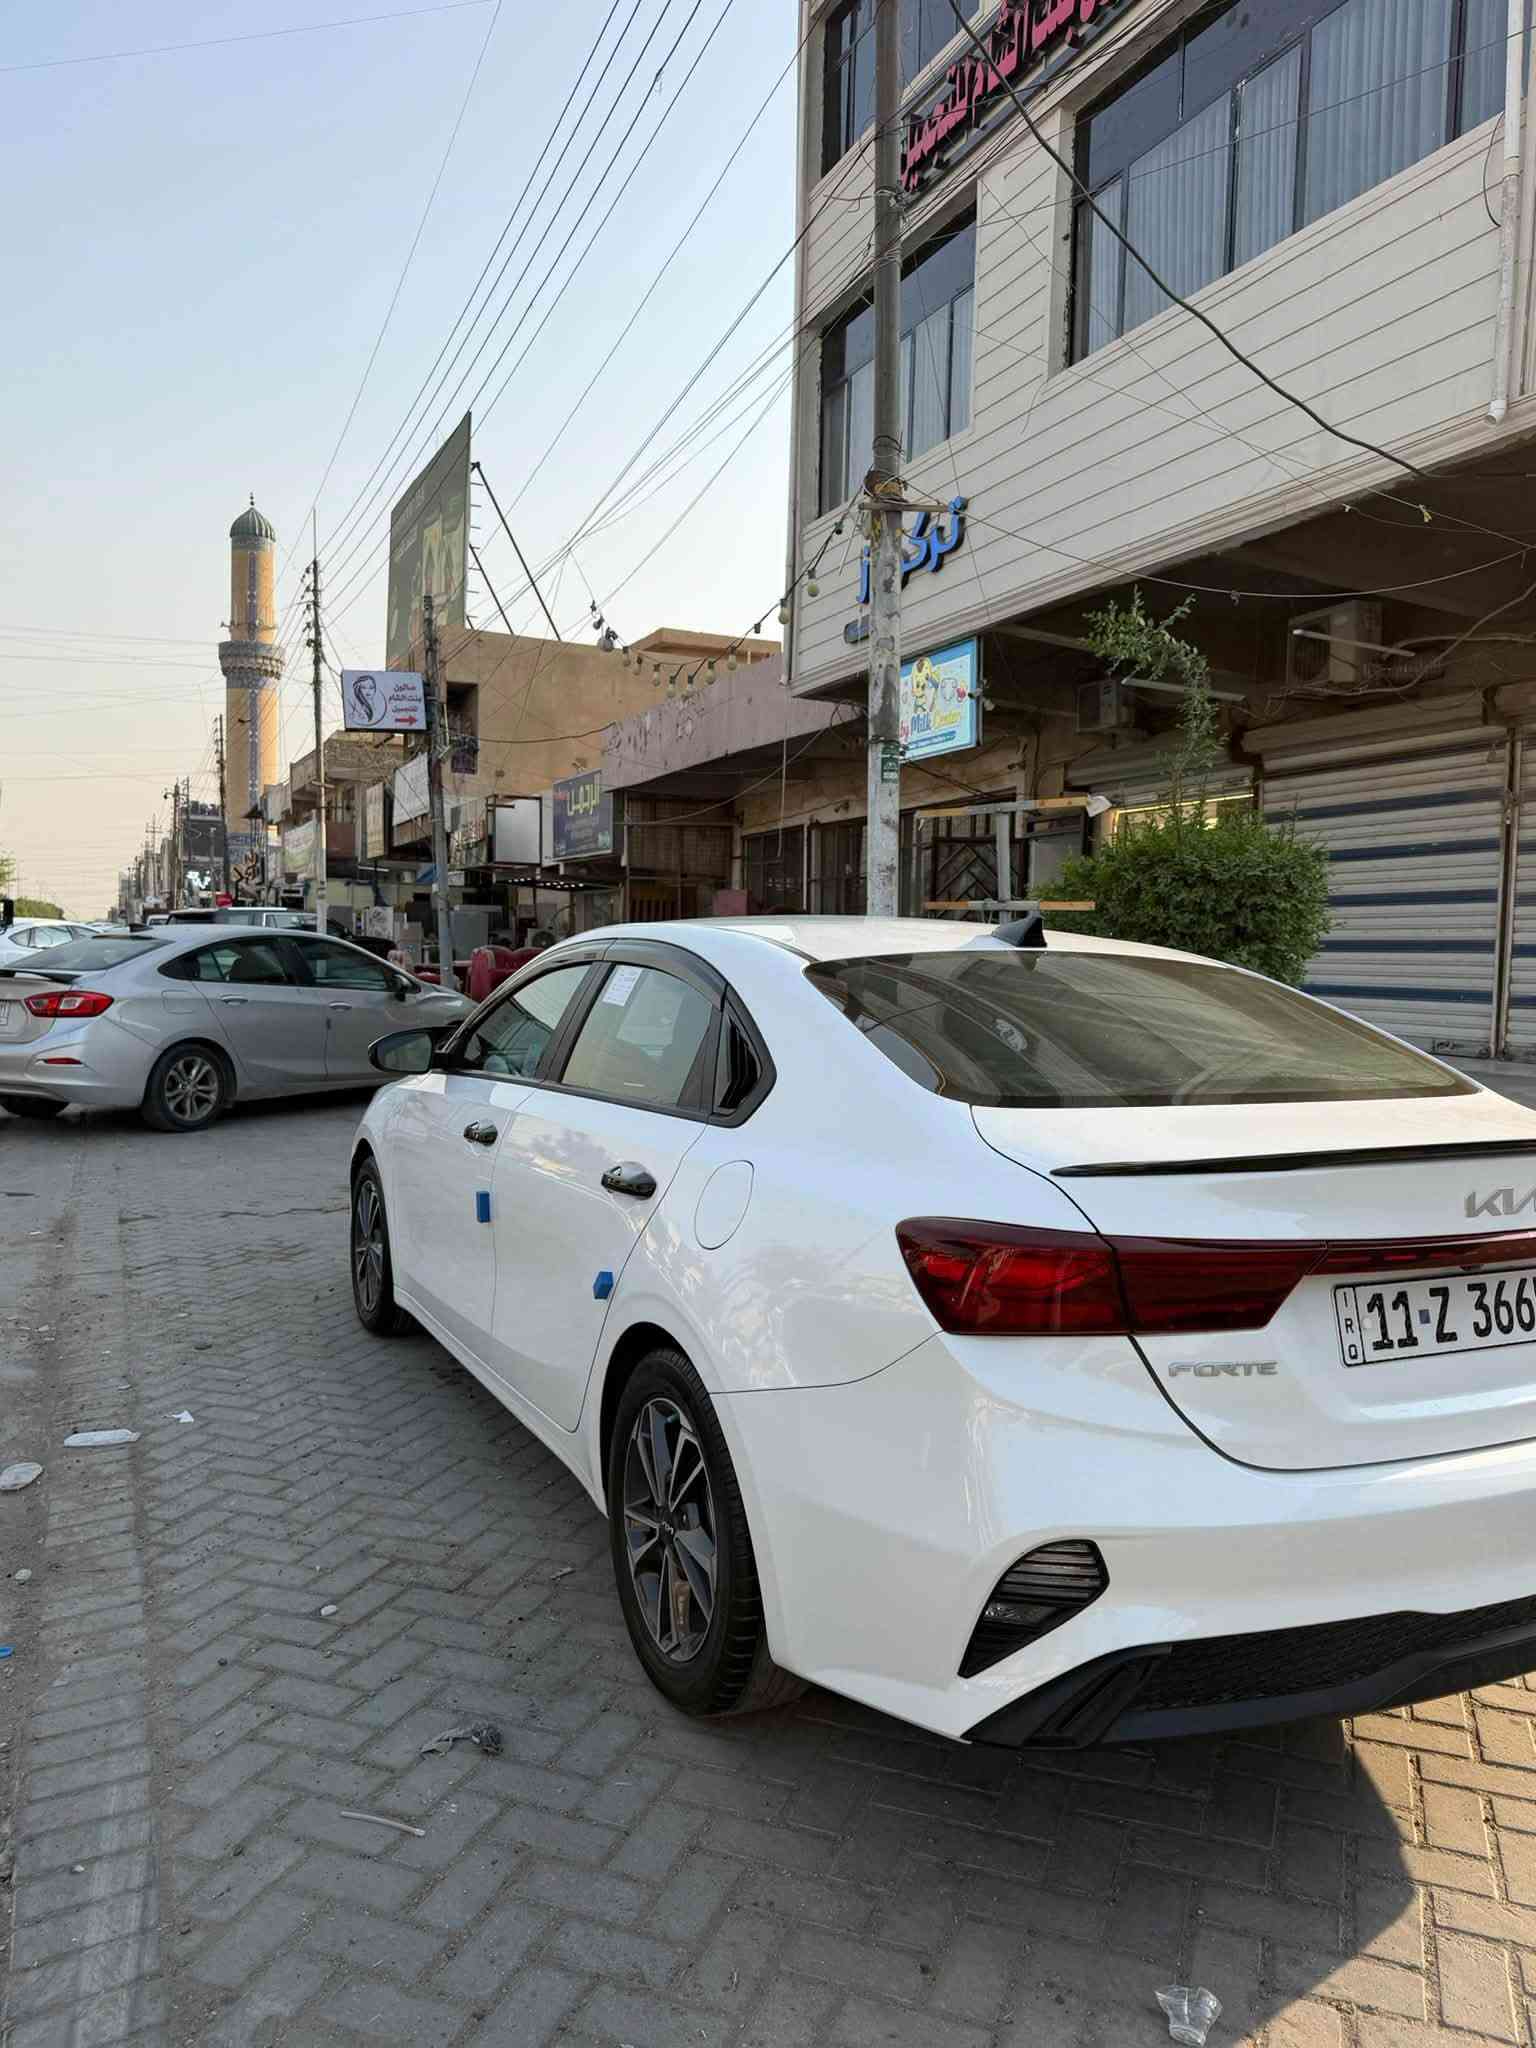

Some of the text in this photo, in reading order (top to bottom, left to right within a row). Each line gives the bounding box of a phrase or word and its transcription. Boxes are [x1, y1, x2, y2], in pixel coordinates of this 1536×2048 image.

[1428, 1286, 1458, 1344] Z
[1466, 1275, 1536, 1338] 366
[1168, 1360, 1279, 1378] FORTE
